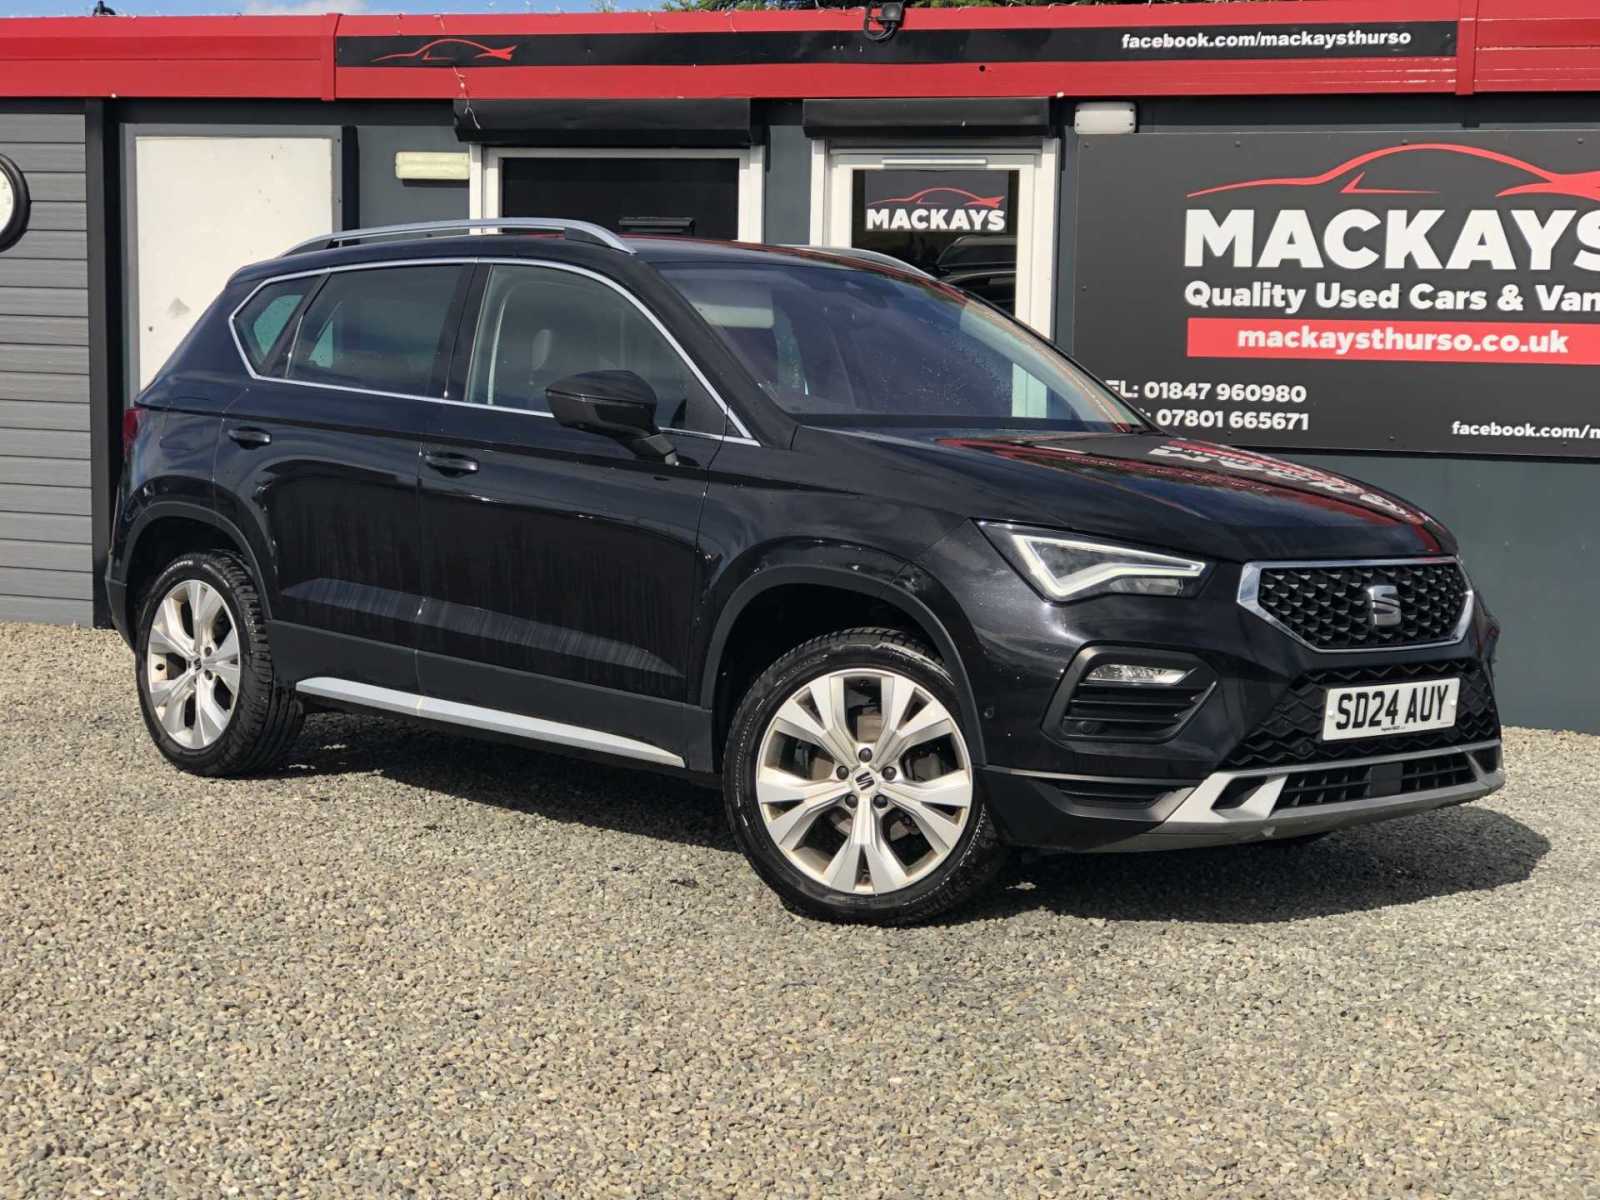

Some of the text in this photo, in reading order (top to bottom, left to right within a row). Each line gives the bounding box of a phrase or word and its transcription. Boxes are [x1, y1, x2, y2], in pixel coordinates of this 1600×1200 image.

[1121, 29, 1412, 50] facebook.com/mackaysthurso
[865, 207, 1006, 232] MACKAYS
[1184, 280, 1307, 315] Quality
[1315, 281, 1400, 310] Used
[1408, 282, 1488, 312] Cars
[1496, 283, 1524, 312] &
[1237, 325, 1569, 355] mackaysthurso.co.uk
[1144, 381, 1212, 400] 01847
[1216, 383, 1307, 403] 960980
[1156, 408, 1224, 428] 07801
[1228, 410, 1309, 431] 665671
[1335, 684, 1449, 730] SD24 AUY
